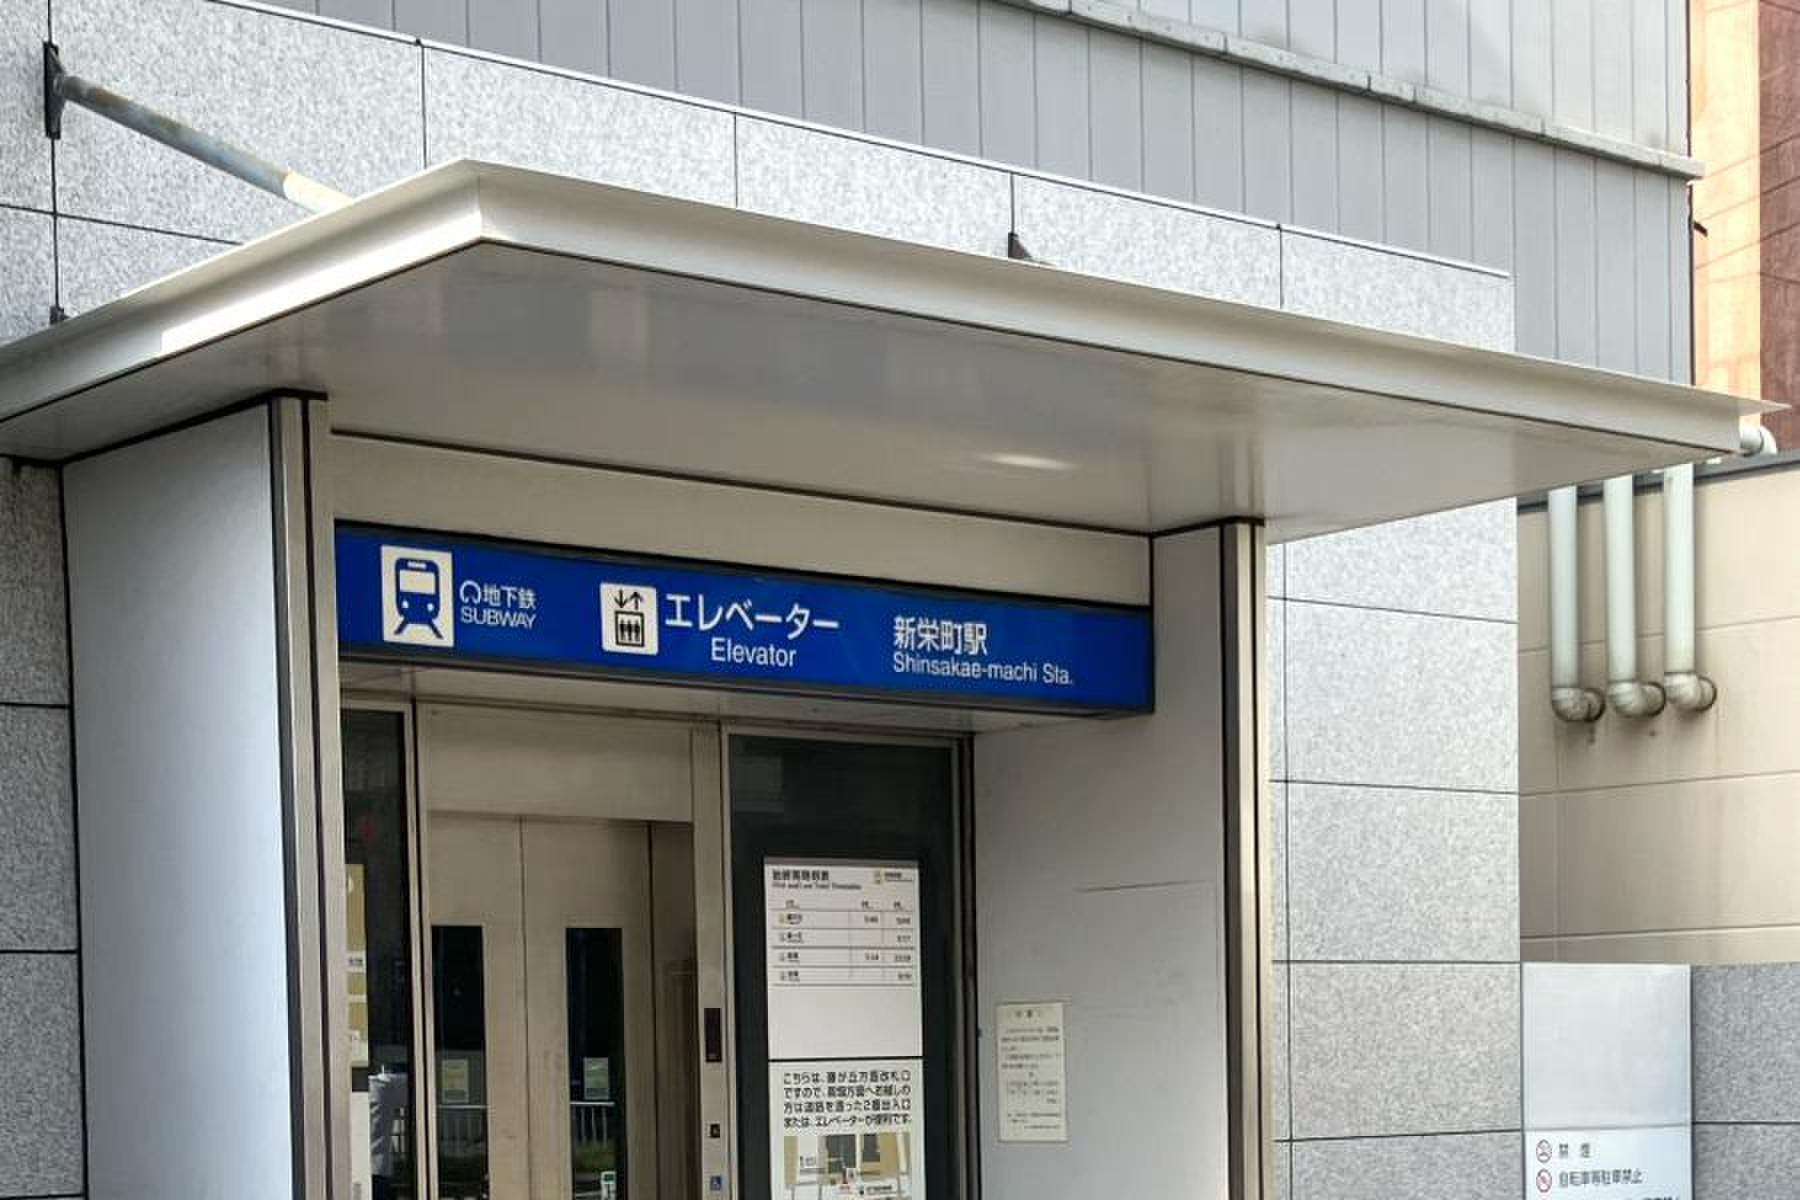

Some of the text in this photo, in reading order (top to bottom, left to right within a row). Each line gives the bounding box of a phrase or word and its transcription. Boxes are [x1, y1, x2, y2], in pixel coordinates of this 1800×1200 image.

[483, 582, 537, 610] 地下鉄
[460, 605, 537, 630] SUBWAY
[664, 593, 840, 640] エレベーター
[893, 615, 988, 656] 新栄町駅
[710, 637, 797, 667] Elevator
[893, 651, 1073, 685] Shinsakae-machi Sta.
